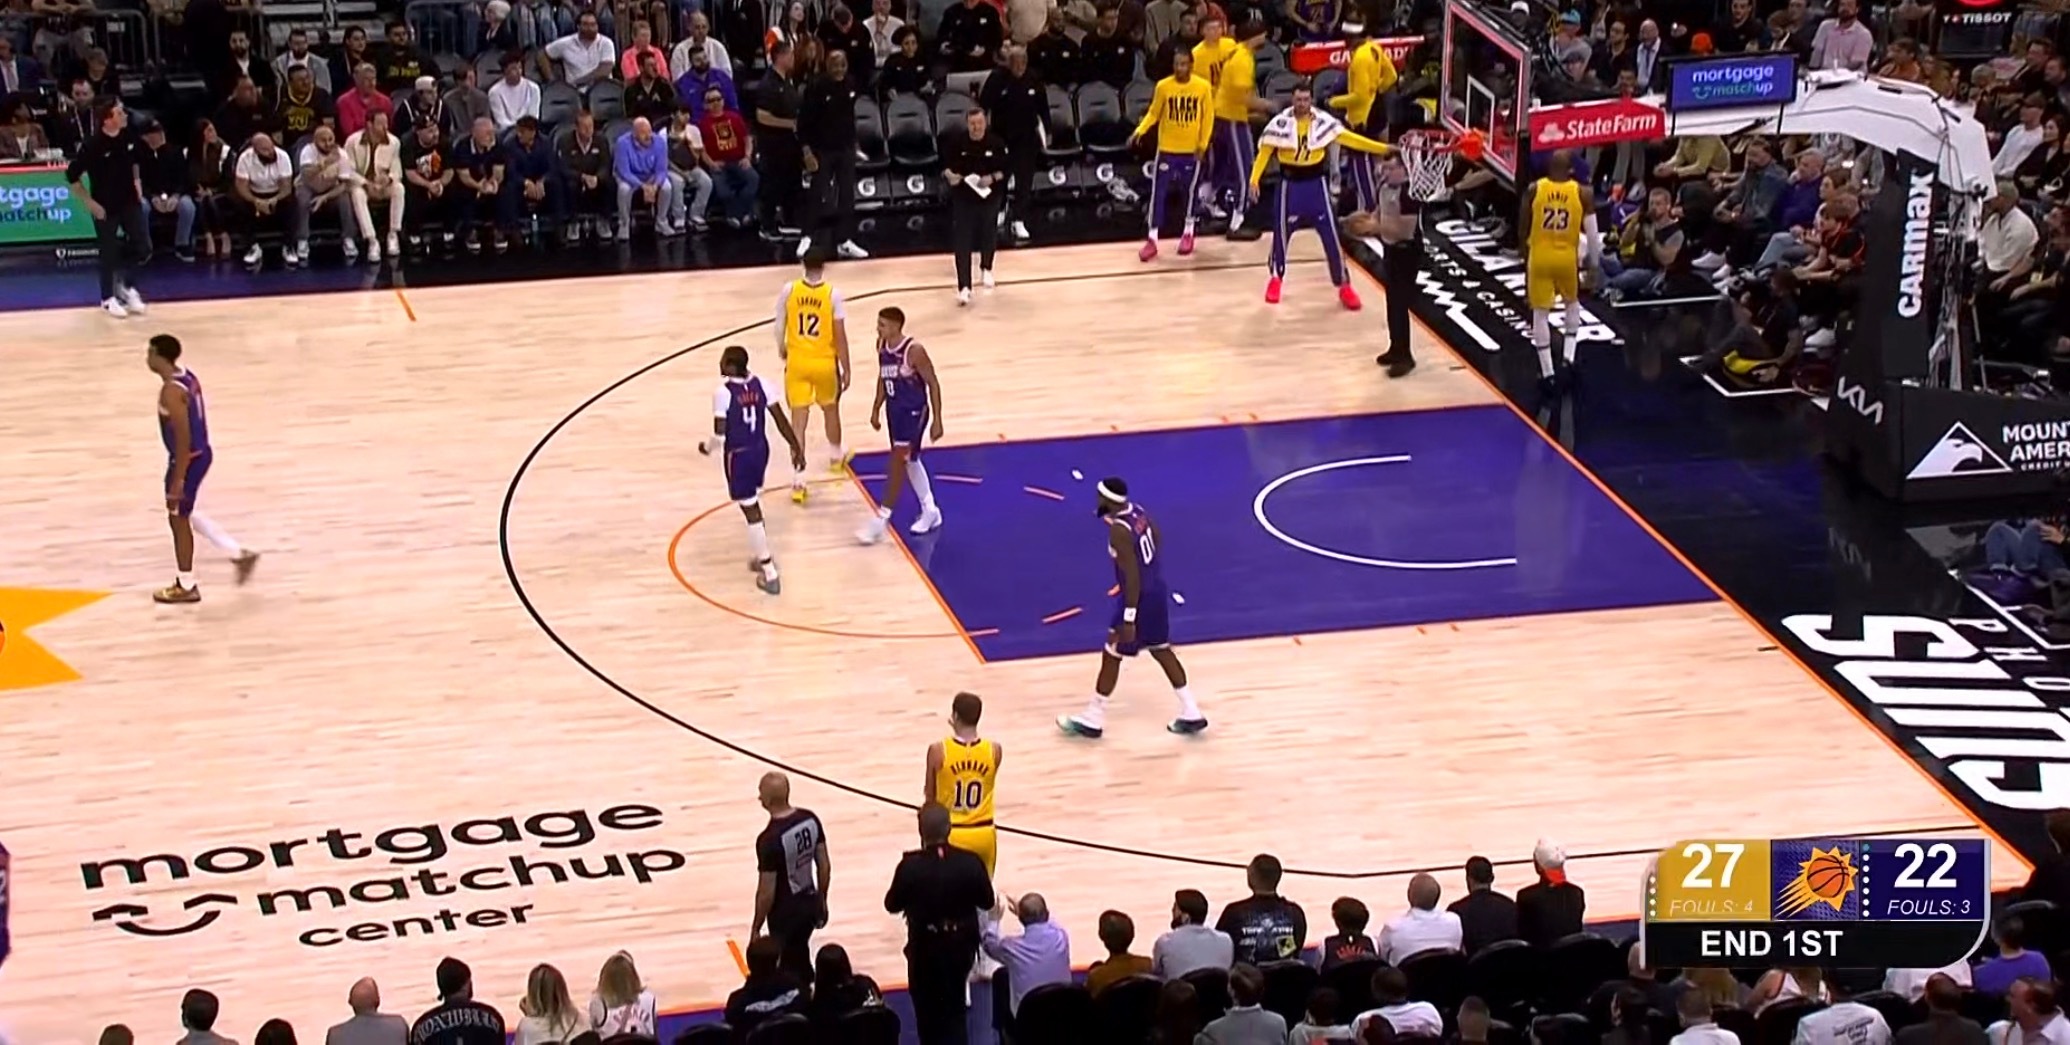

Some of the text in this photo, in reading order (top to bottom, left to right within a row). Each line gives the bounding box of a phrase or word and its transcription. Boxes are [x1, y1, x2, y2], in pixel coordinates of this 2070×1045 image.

[1962, 12, 2012, 25] TISSOT
[1692, 65, 1774, 83] mortgage
[1712, 81, 1773, 96] matchup
[0, 206, 72, 224] atchup
[1542, 207, 1570, 231] 23
[798, 312, 820, 337] 12
[742, 404, 757, 433] 4
[954, 780, 982, 810] 10
[81, 803, 663, 889] mortgage
[795, 827, 812, 856] 28
[257, 848, 686, 914] matchup
[299, 904, 534, 947] center
